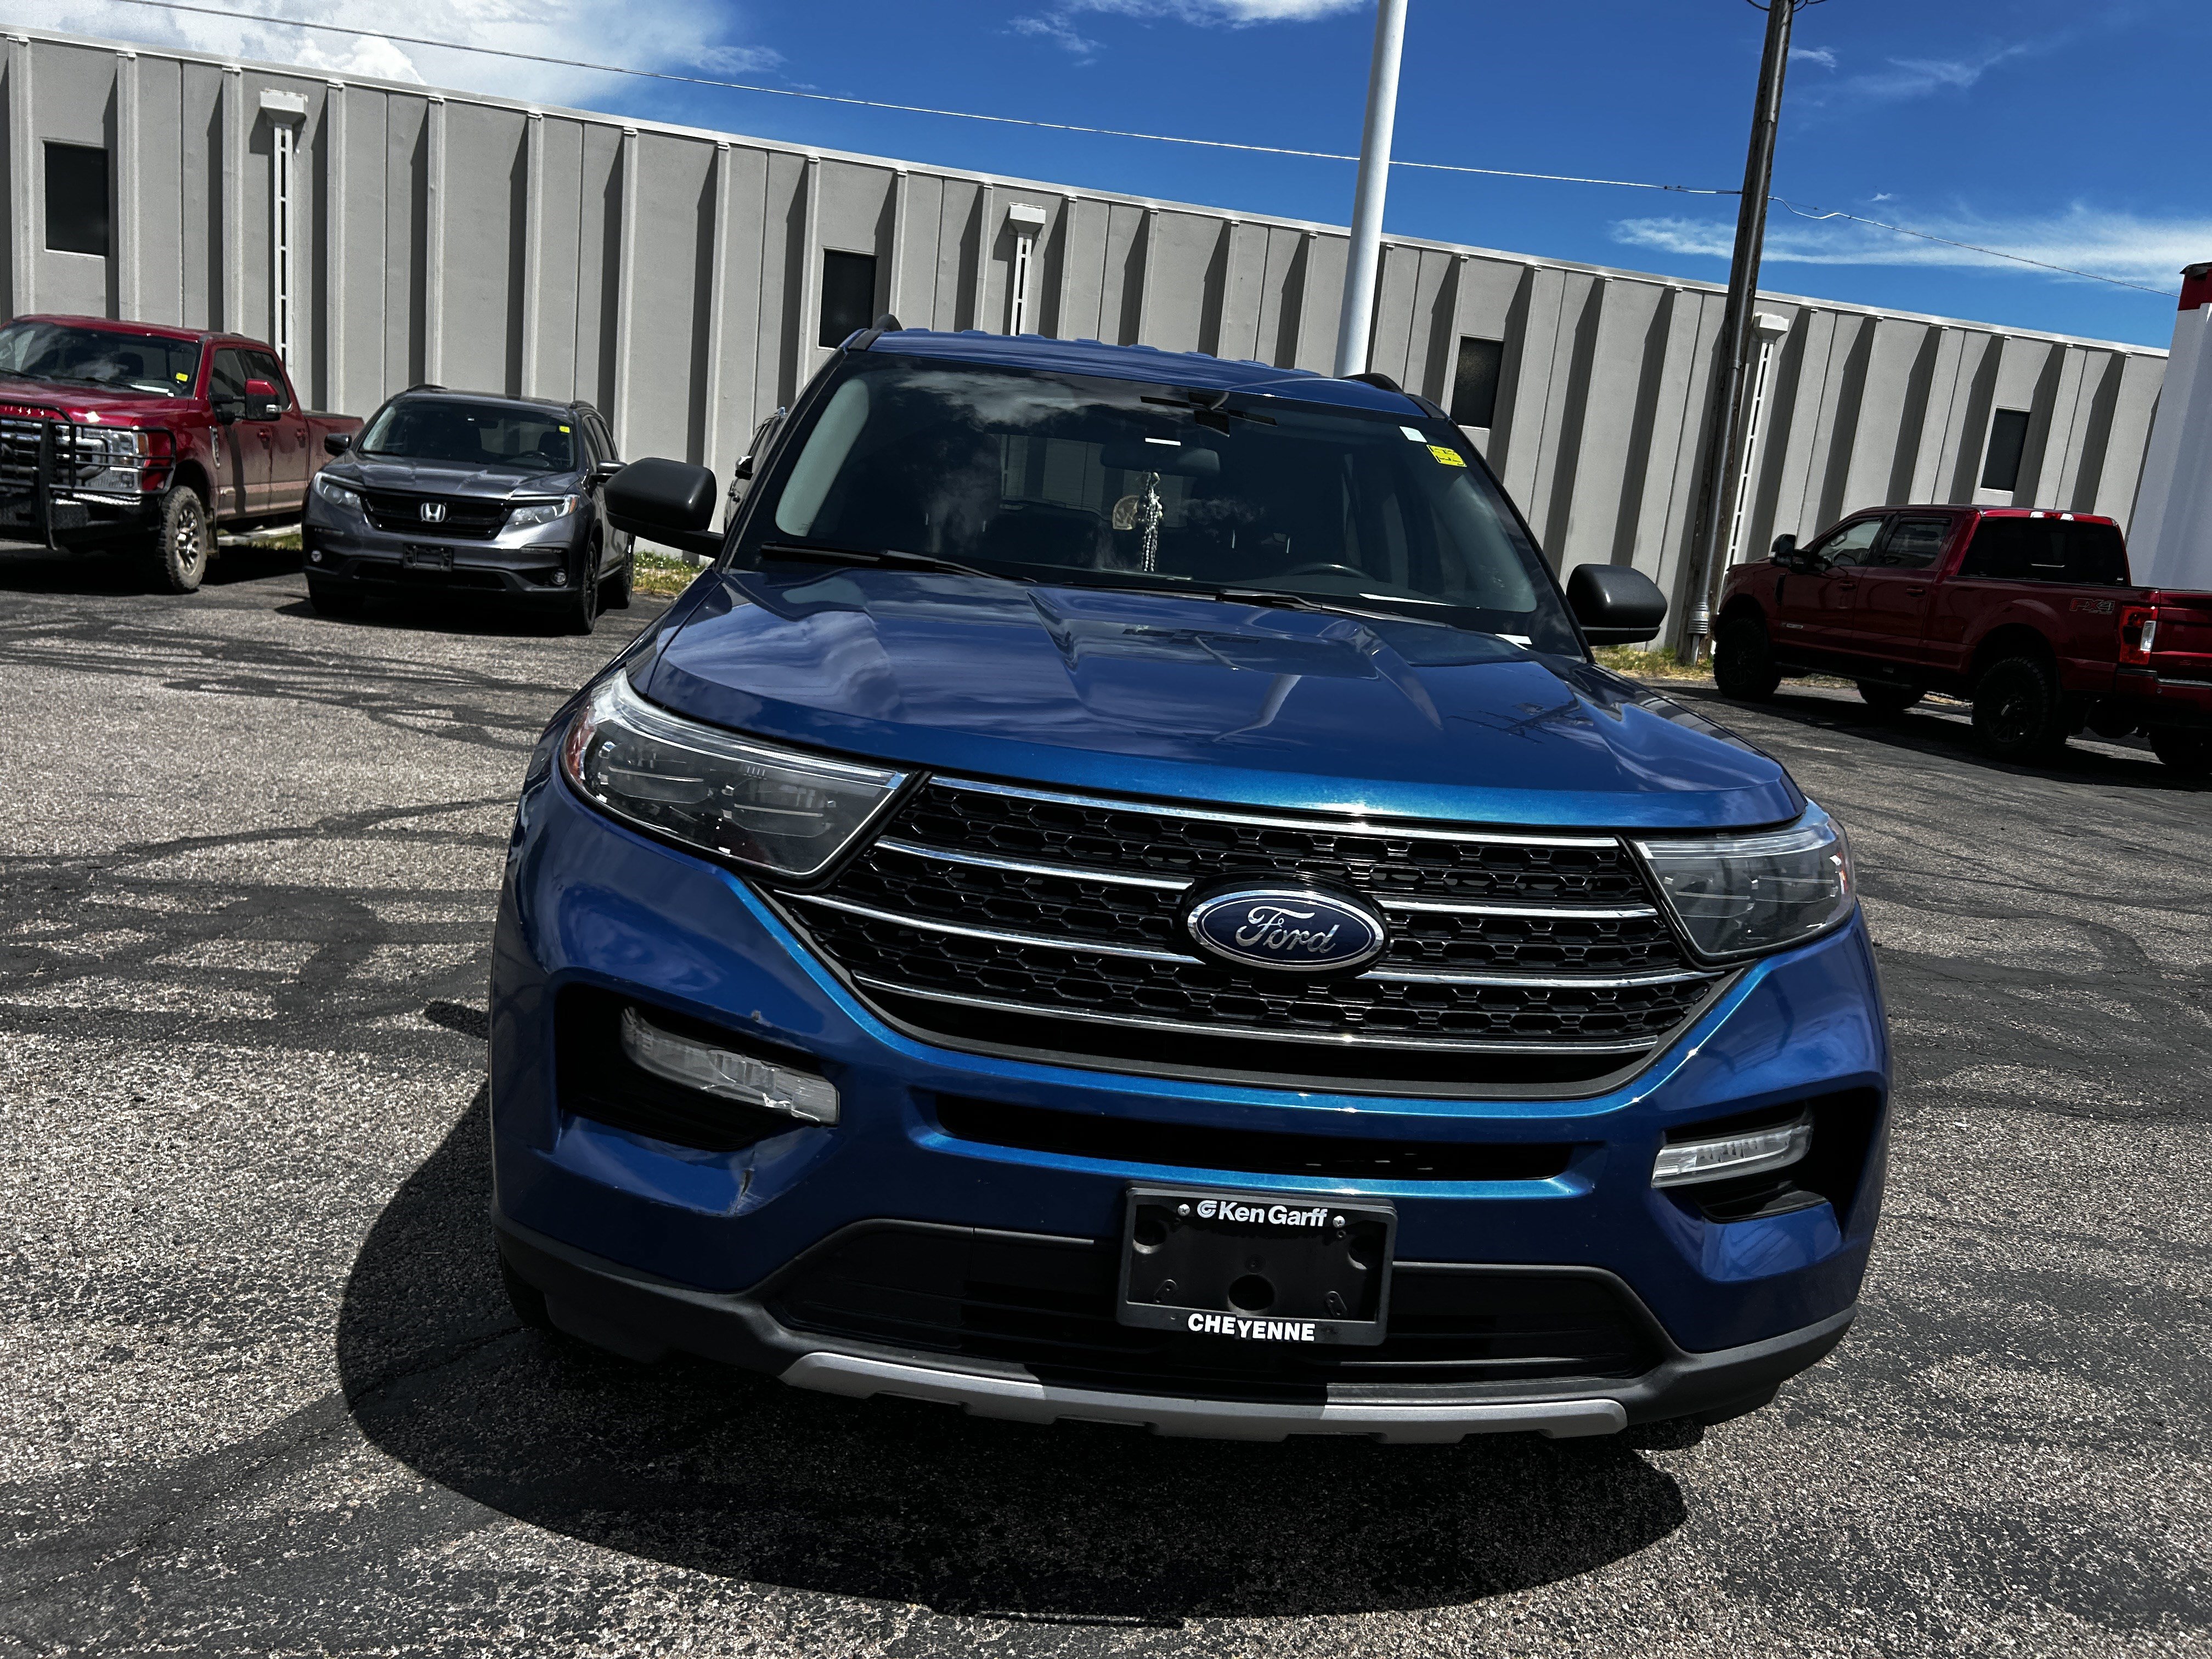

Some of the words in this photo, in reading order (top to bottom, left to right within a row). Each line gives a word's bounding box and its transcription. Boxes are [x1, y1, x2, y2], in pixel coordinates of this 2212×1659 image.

[1235, 906, 1340, 953] Ford
[1218, 1201, 1265, 1223] Ken
[1268, 1206, 1327, 1227] Garff
[1188, 1313, 1316, 1341] CHEYENNE
